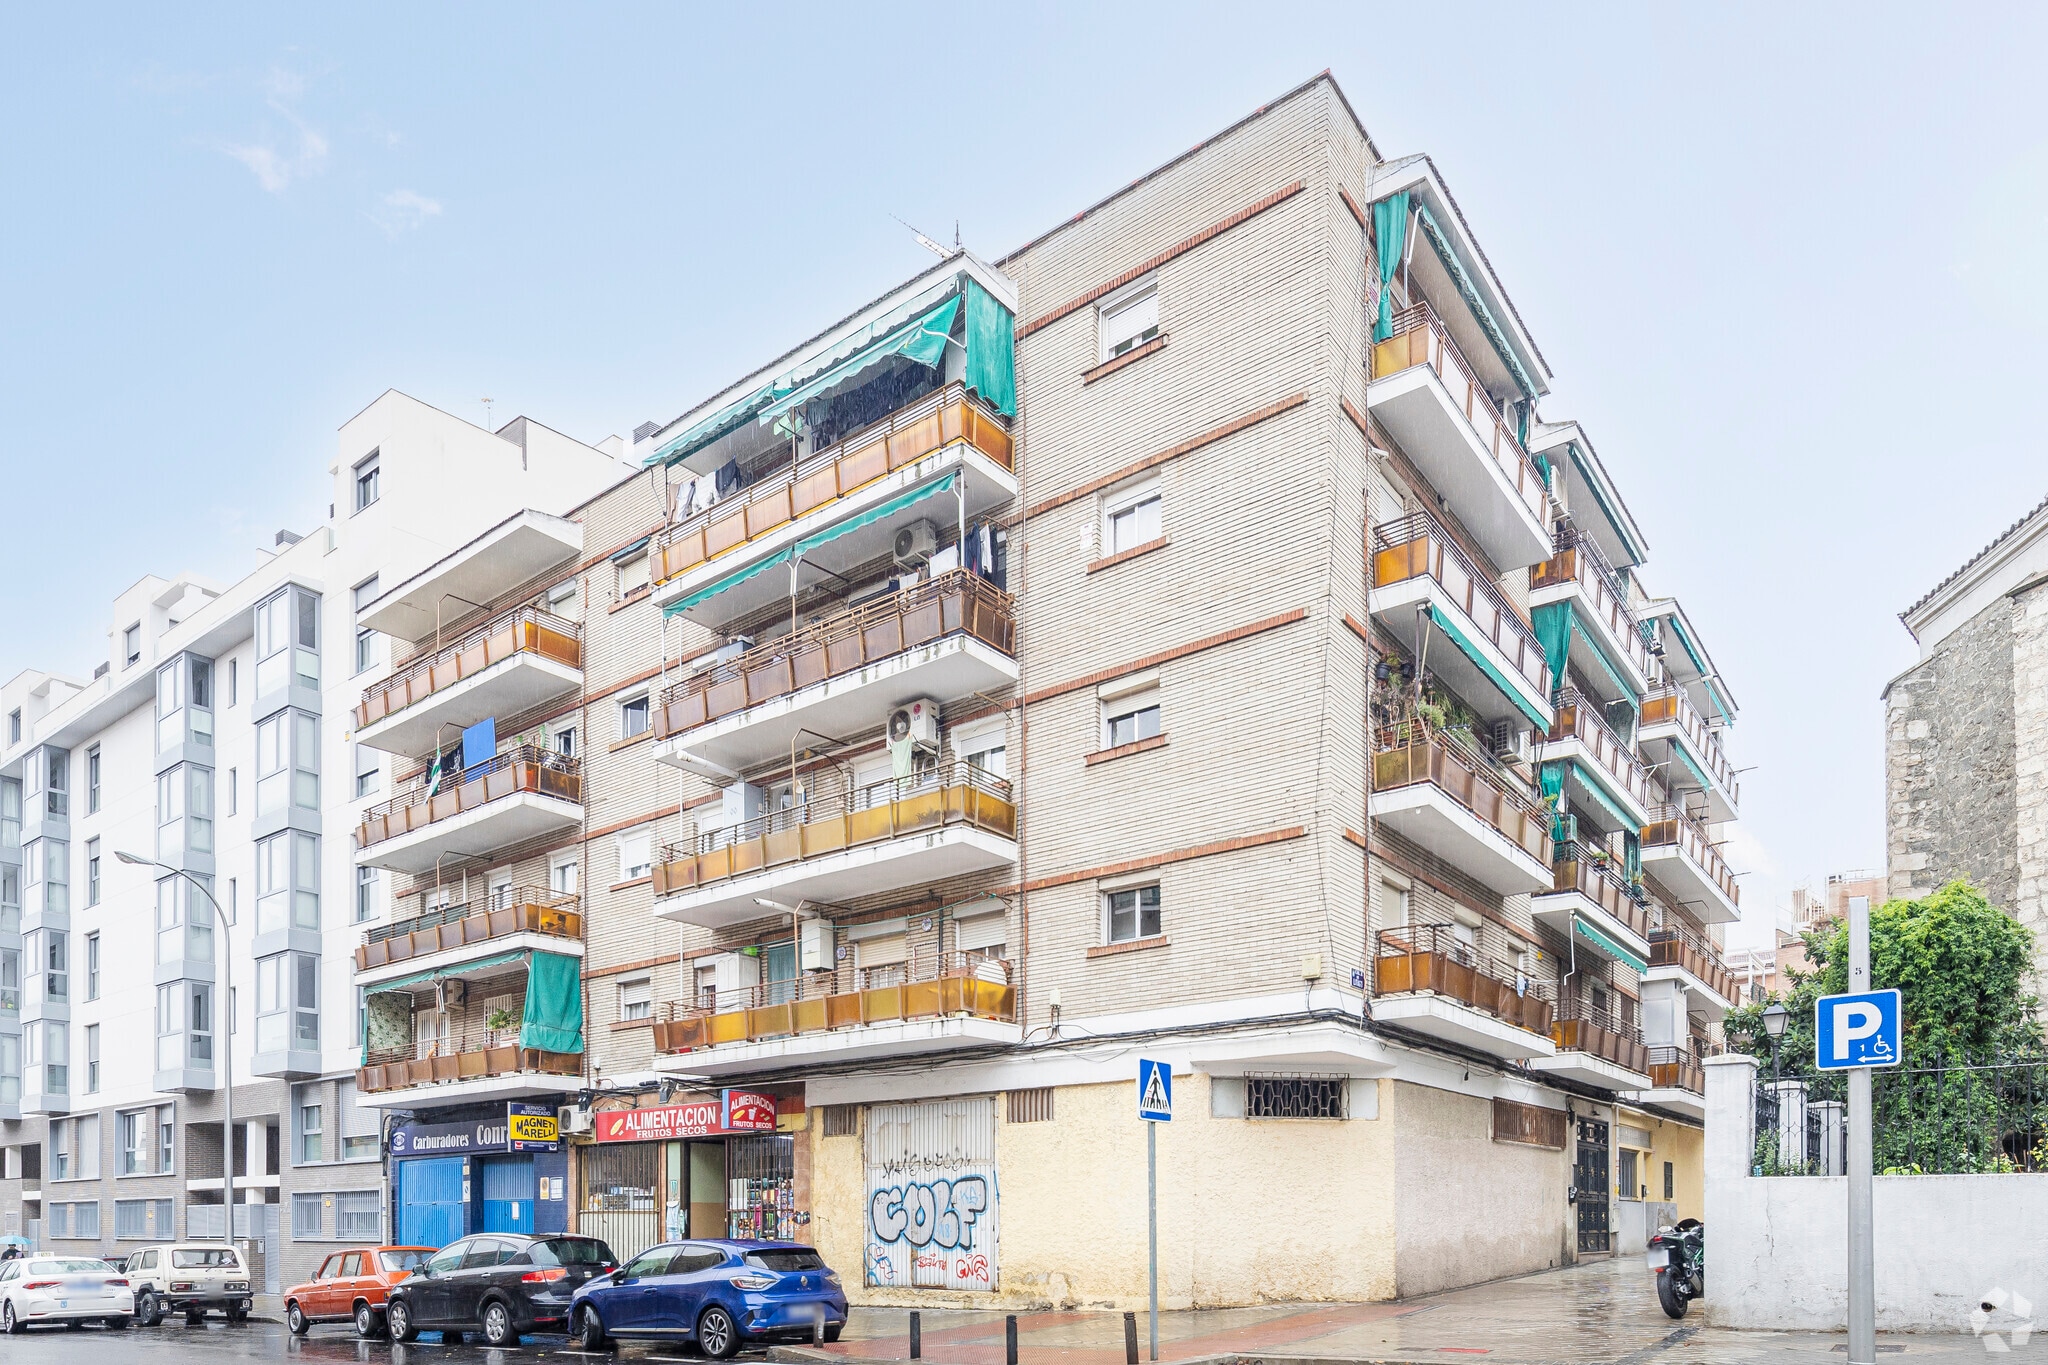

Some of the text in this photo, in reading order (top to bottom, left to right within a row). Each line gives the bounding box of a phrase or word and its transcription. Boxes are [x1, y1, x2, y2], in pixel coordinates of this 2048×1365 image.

[1855, 967, 1862, 975] 5
[1833, 1001, 1883, 1060] P
[1860, 1044, 1865, 1052] 1
[730, 1094, 775, 1116] ALIMENTACION
[520, 1109, 551, 1117] AUTORIZADO
[625, 1106, 716, 1131] ALIMENTACION
[732, 1120, 773, 1129] FRUTOS SECOS
[412, 1134, 470, 1151] Carburadores
[476, 1124, 508, 1146] Conr
[636, 1126, 708, 1139] FRUTOS SECOS
